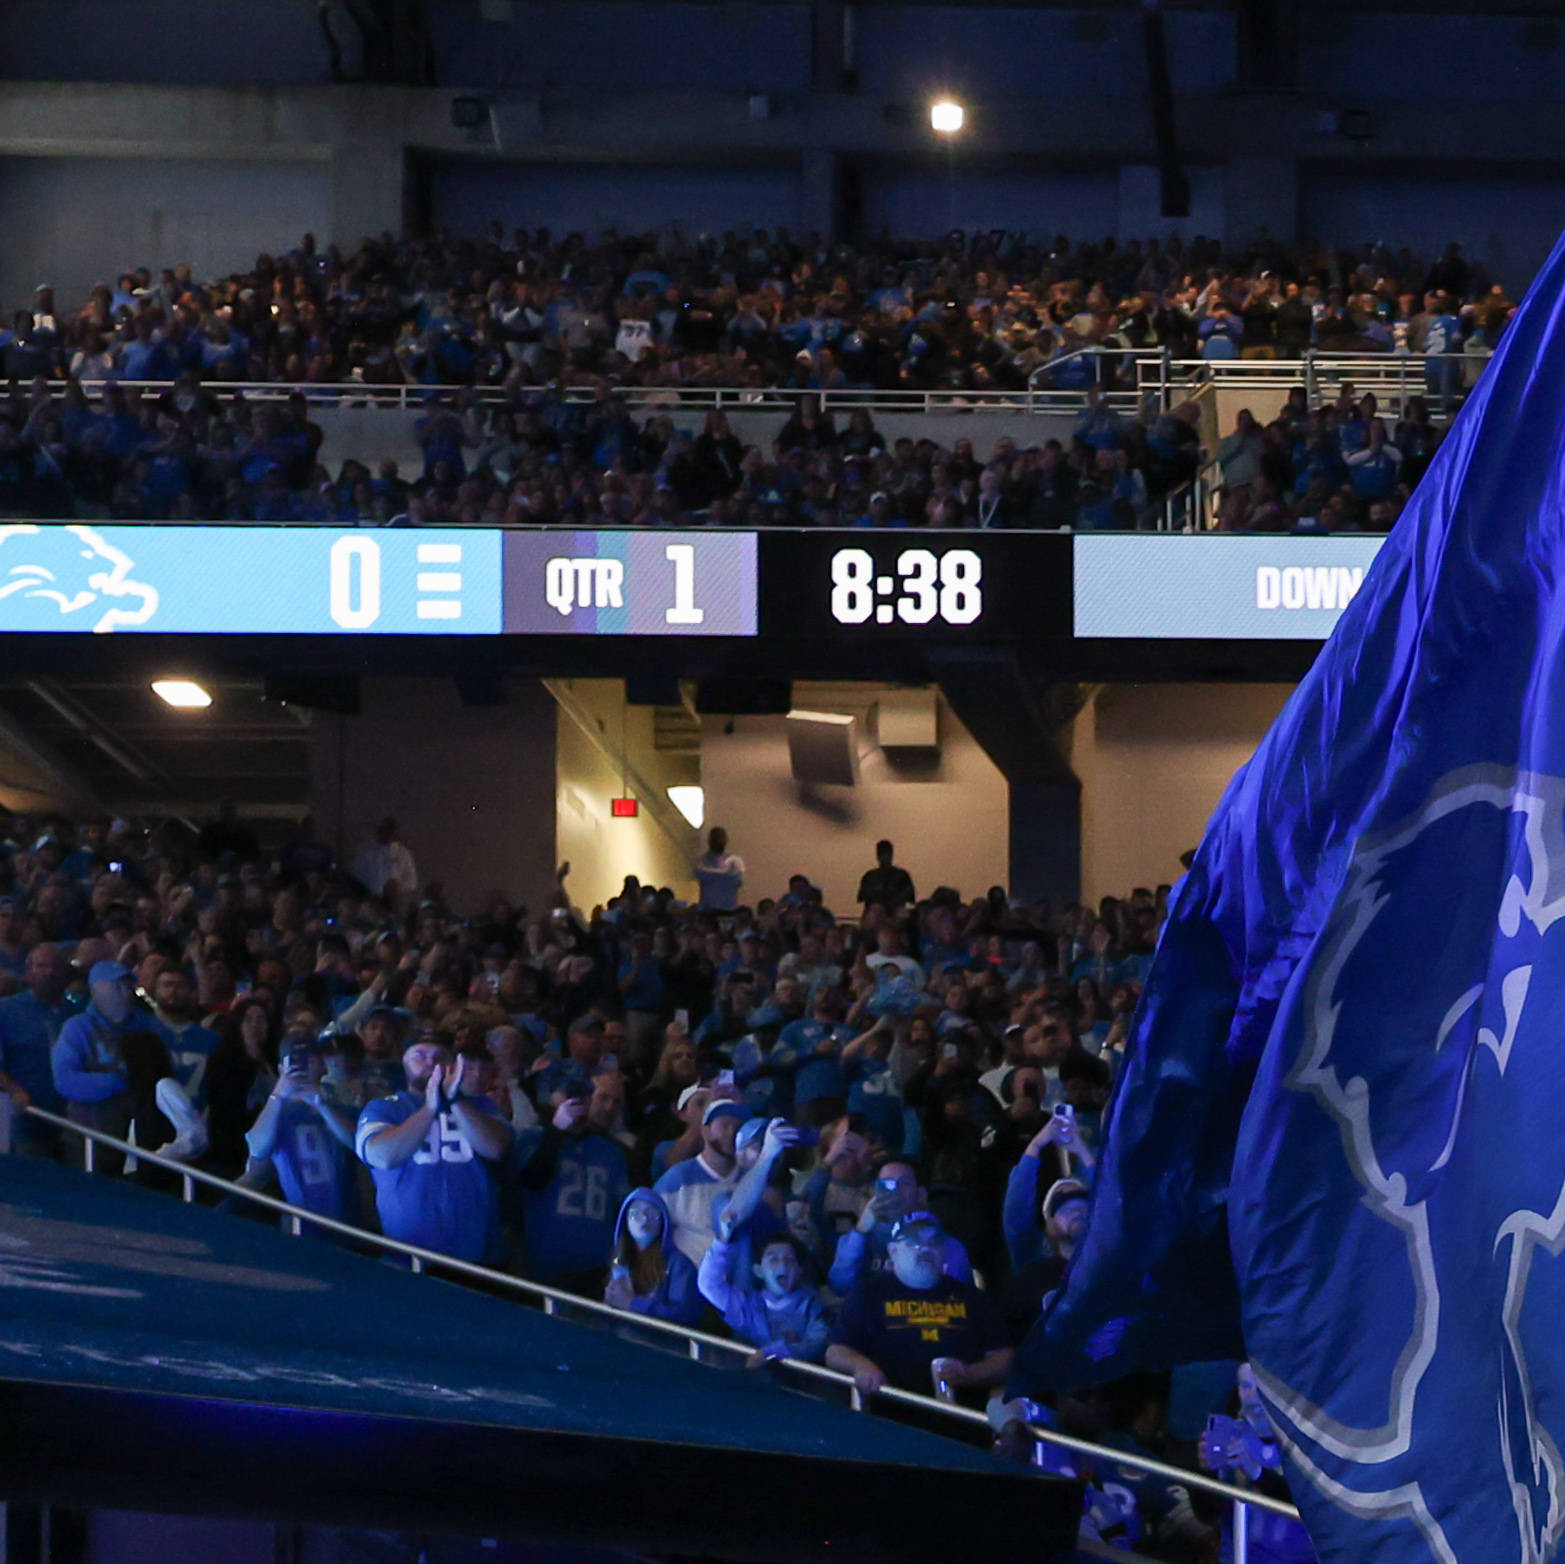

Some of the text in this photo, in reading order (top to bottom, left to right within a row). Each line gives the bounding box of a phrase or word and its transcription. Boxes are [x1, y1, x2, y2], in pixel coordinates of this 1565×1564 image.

[330, 534, 380, 629] 0
[546, 545, 704, 624] QTR 1
[830, 548, 982, 624] 8:38
[1256, 566, 1363, 609] DOWN
[885, 1301, 967, 1318] MICHIGAN
